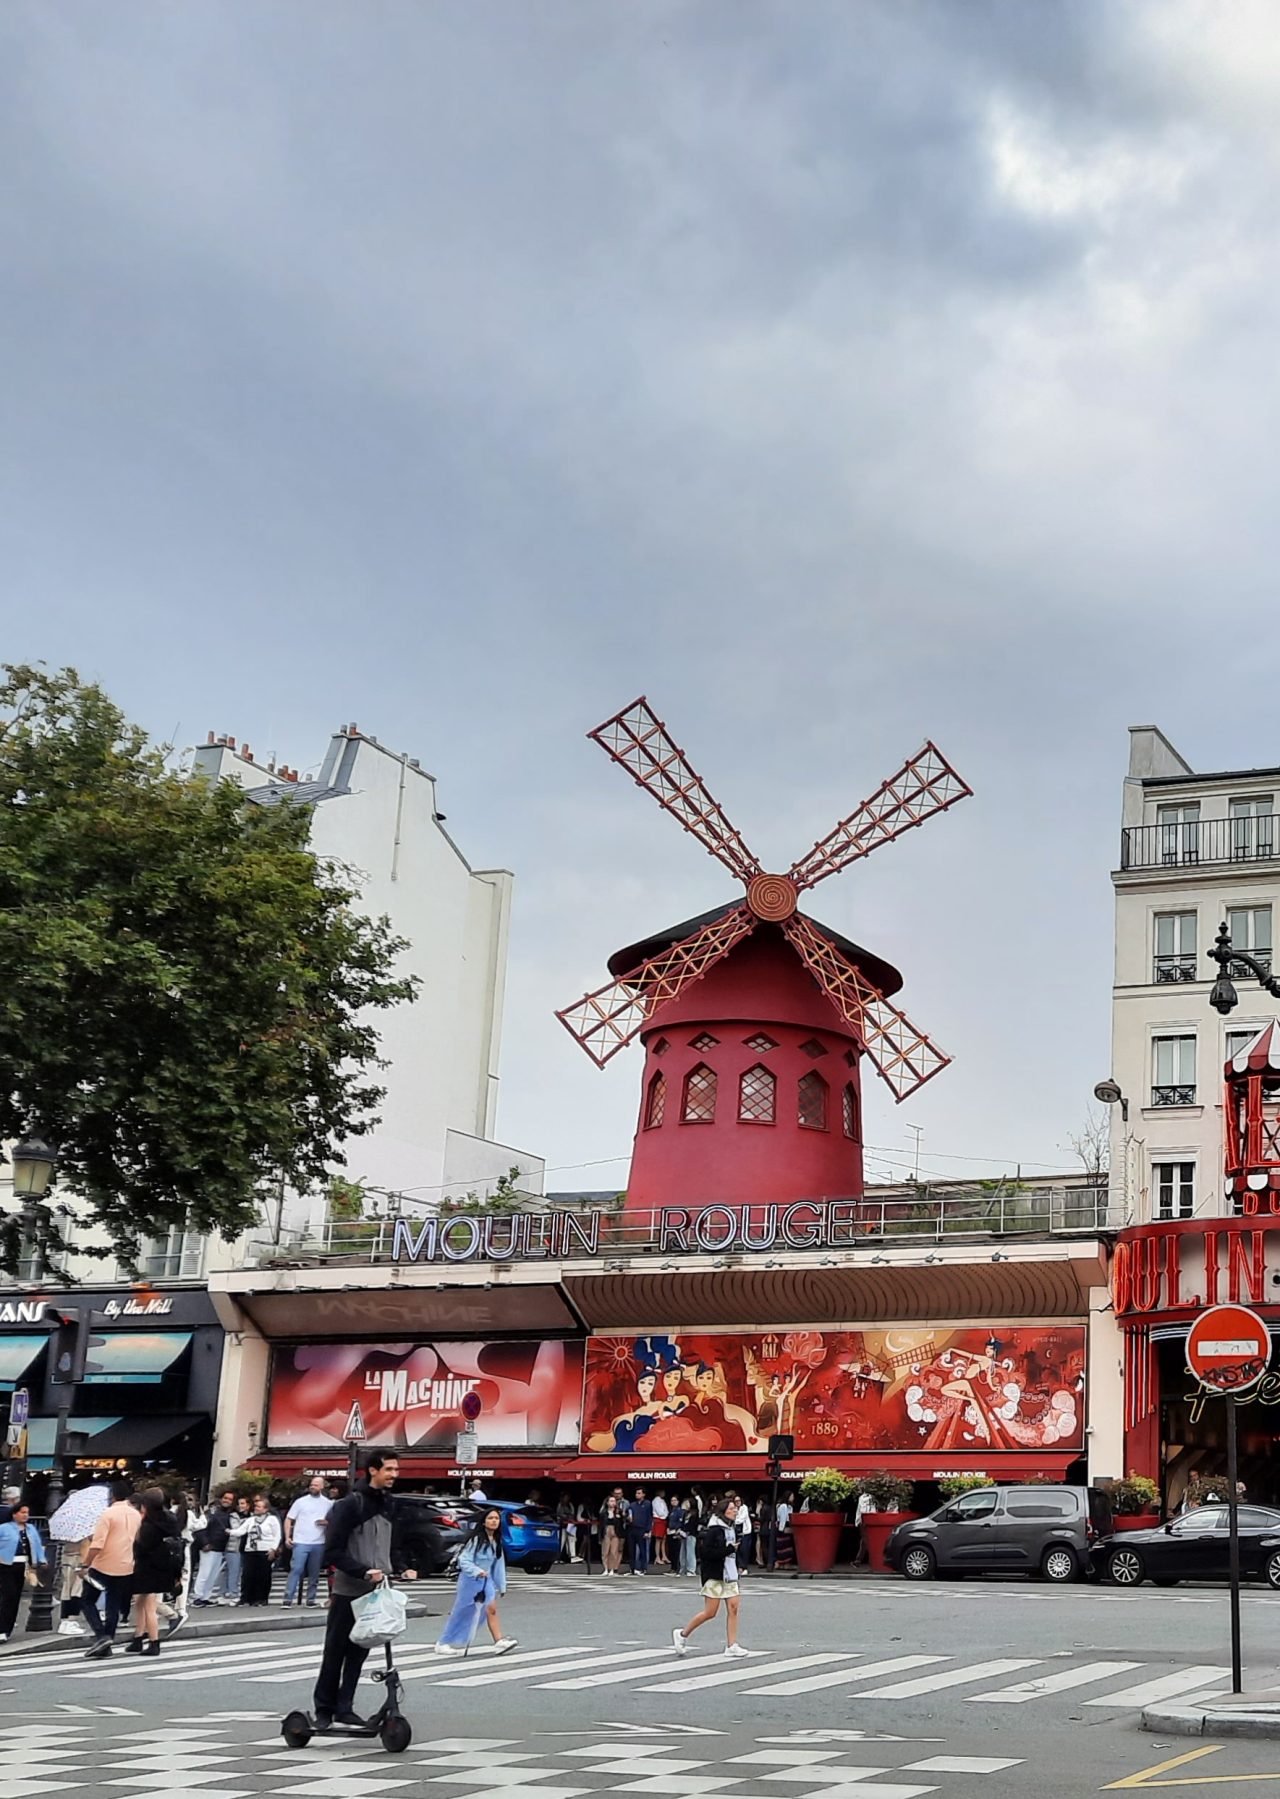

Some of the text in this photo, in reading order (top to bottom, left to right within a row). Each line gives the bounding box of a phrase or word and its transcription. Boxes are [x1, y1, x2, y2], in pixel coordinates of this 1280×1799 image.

[391, 1201, 857, 1262] MOULIN ROUGE
[0, 1302, 47, 1323] ANS
[104, 1298, 173, 1321] By the Mill
[365, 1370, 381, 1385] LA
[811, 1422, 839, 1437] 1889
[627, 1471, 678, 1480] MOULIN ROUGE
[932, 1471, 960, 1479] MOULIN
